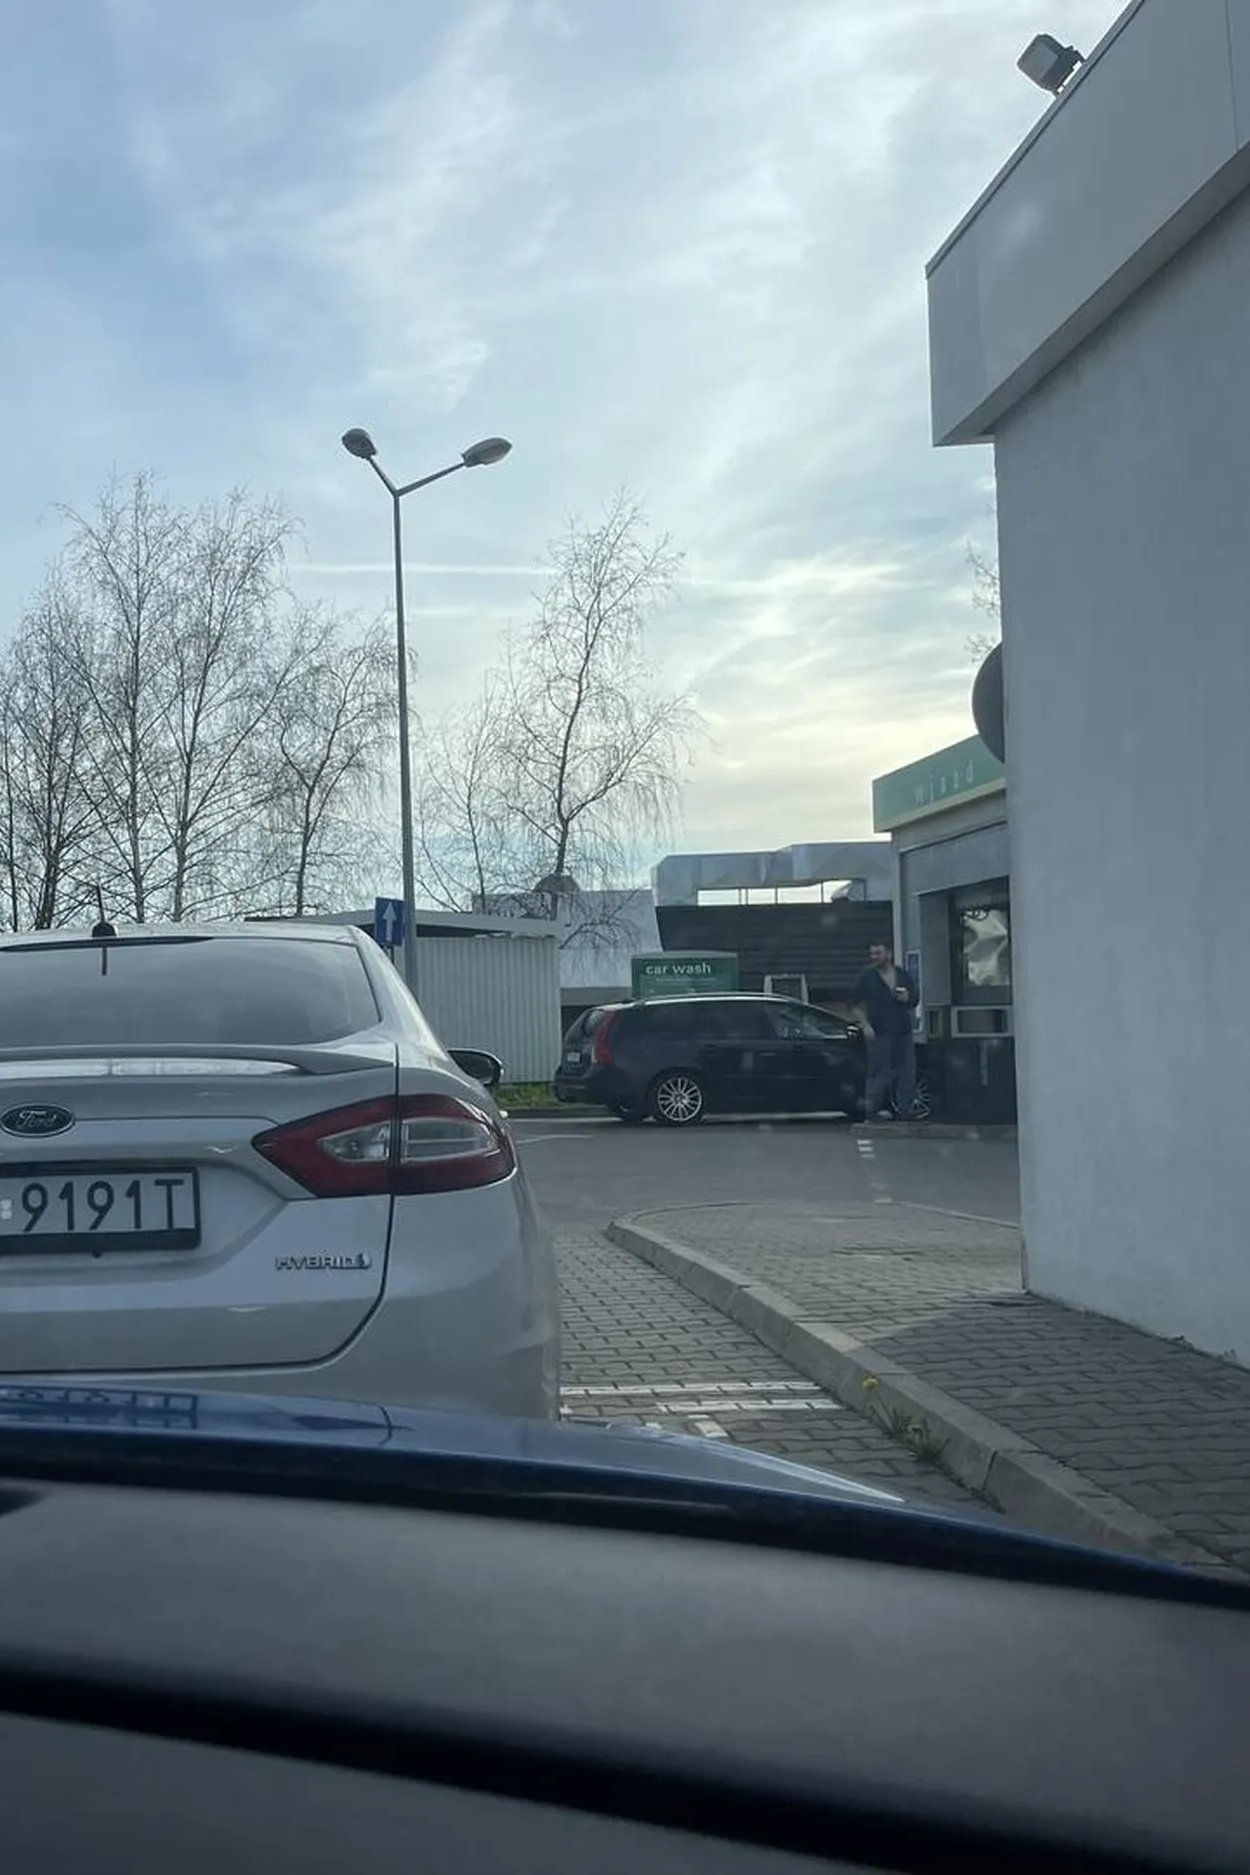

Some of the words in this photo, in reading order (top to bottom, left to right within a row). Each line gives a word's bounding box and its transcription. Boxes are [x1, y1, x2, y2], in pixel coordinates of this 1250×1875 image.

[645, 964, 667, 975] car
[671, 962, 712, 975] wash
[22, 1178, 184, 1233] 9191T
[275, 1256, 356, 1270] HYBRID
